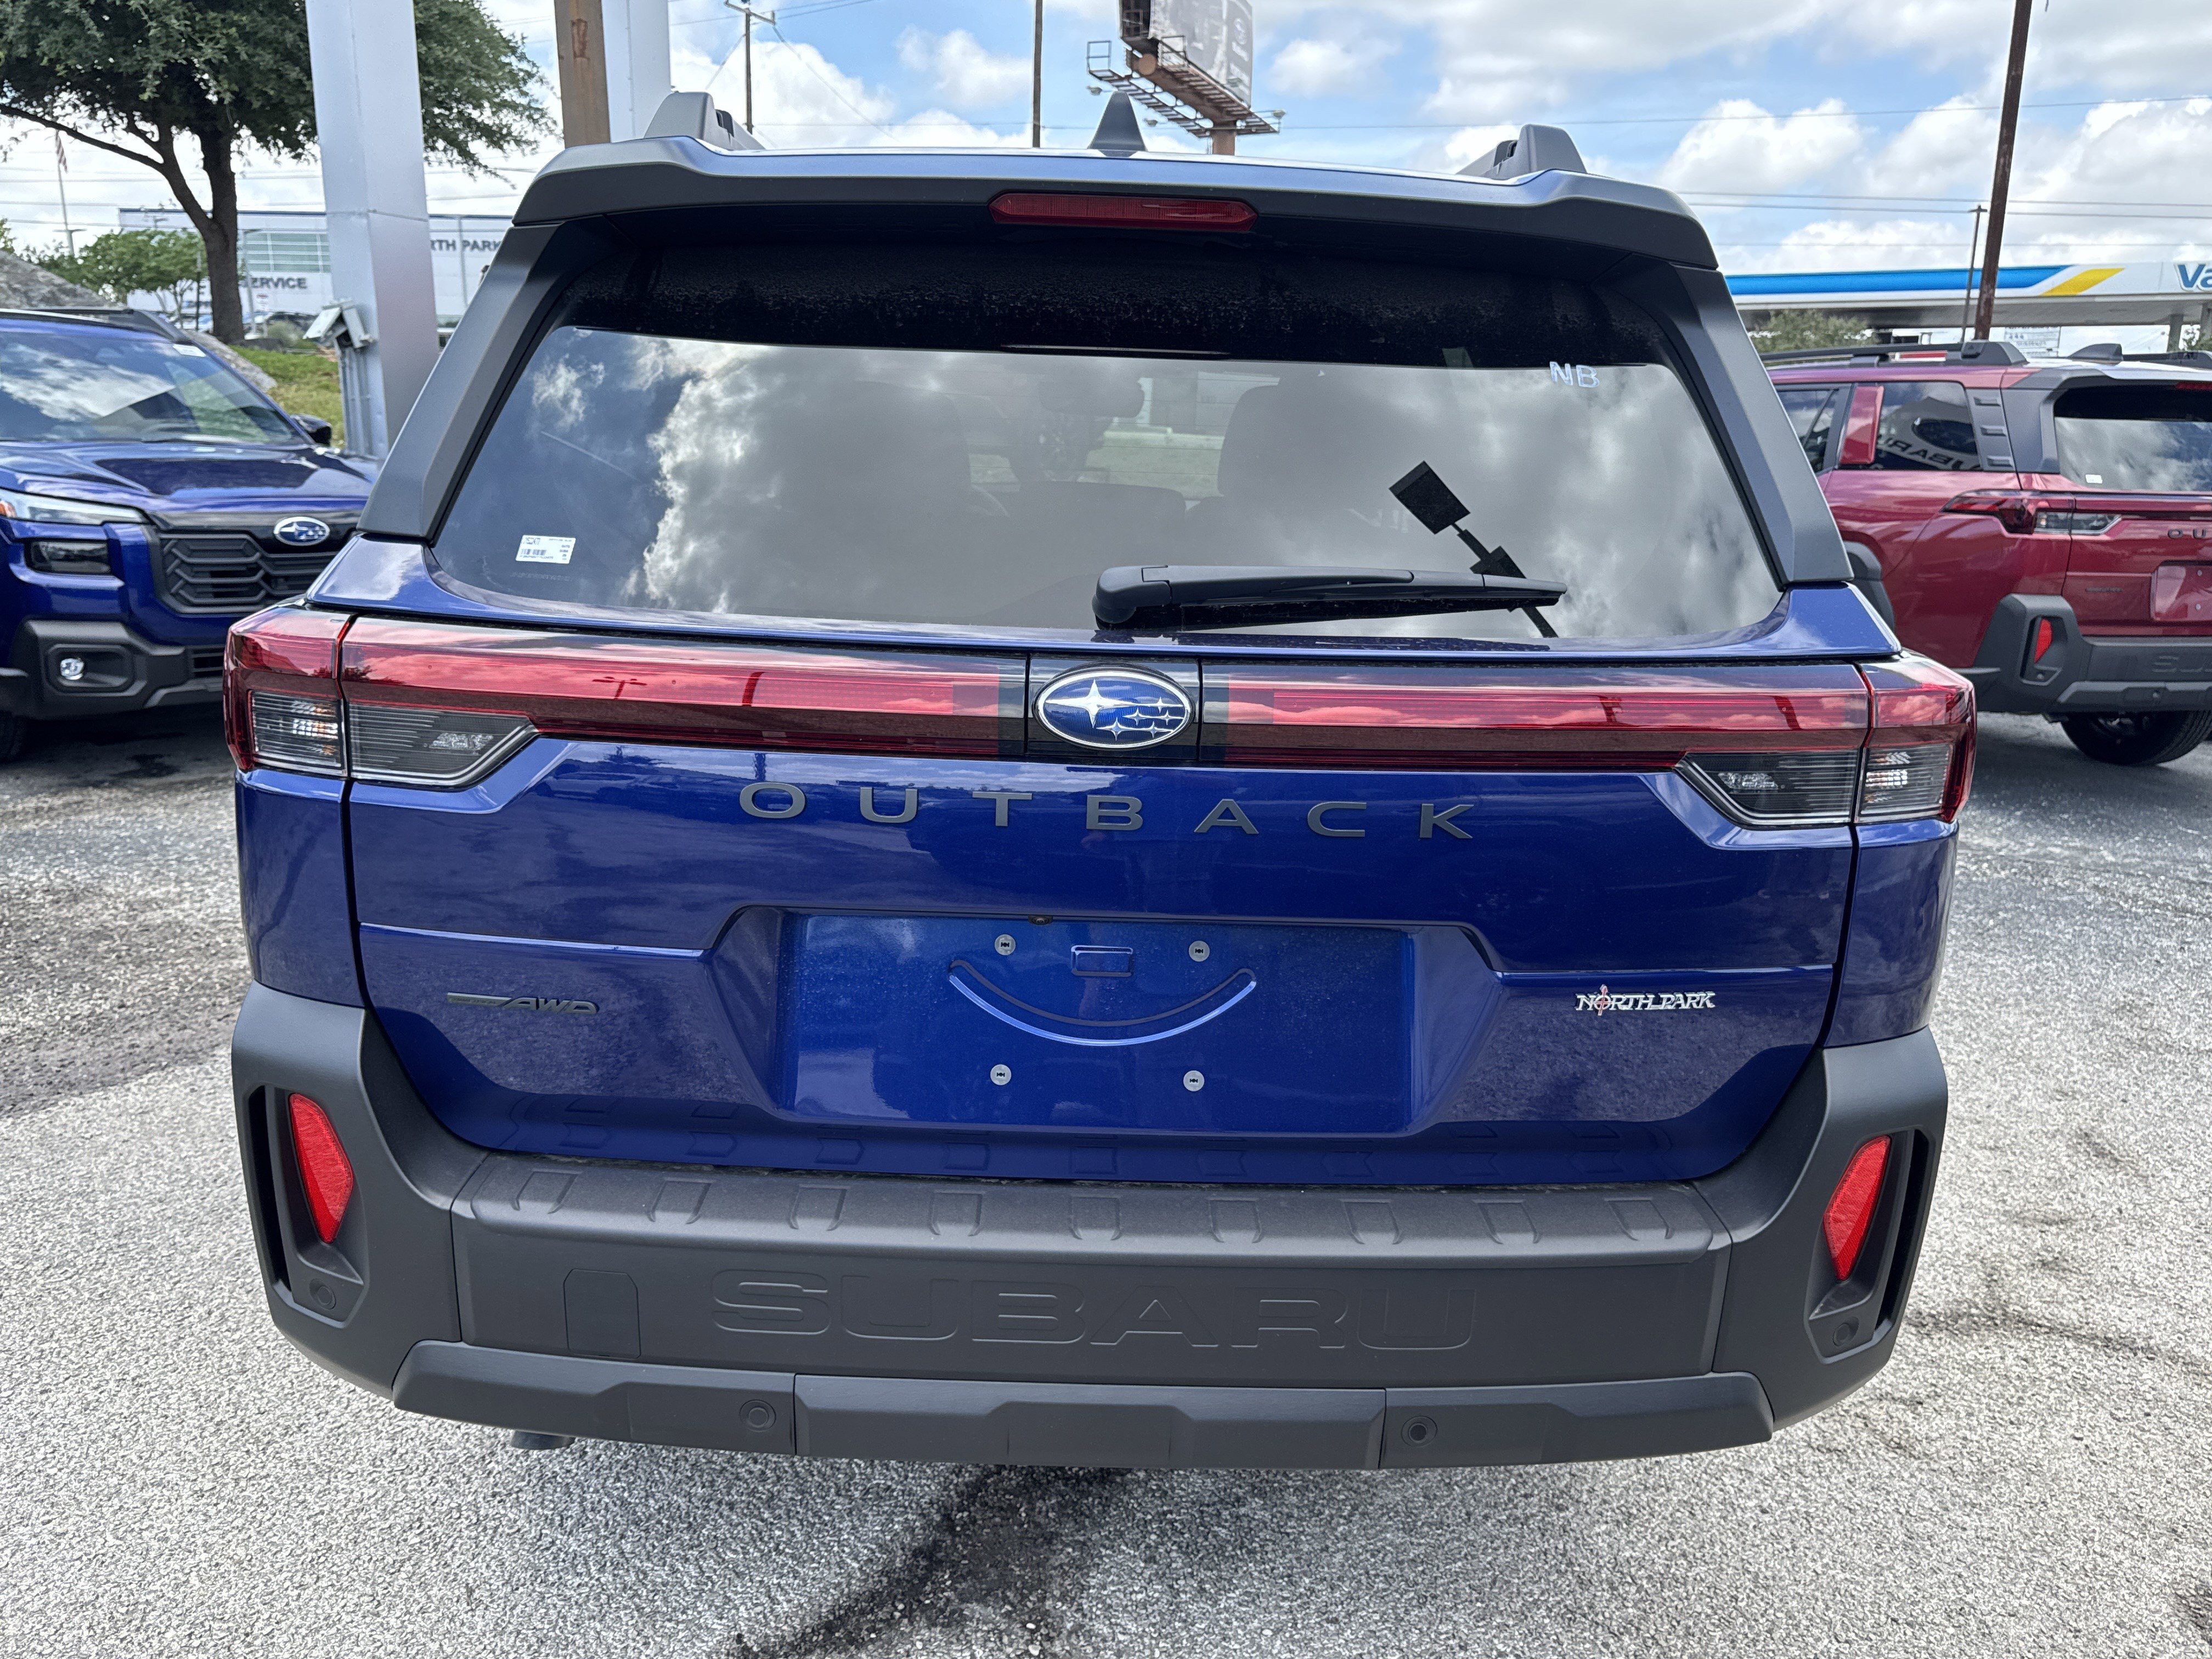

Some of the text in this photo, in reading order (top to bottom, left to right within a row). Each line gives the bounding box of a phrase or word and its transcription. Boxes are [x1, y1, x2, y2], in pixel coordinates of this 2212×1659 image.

[2177, 264, 2212, 288] Va
[1549, 361, 1600, 388] NB
[739, 781, 1475, 840] OUTBACK
[502, 996, 600, 1015] AWD
[1575, 989, 1716, 1012] NORTH PARK
[710, 1268, 1477, 1352] SUBARU
